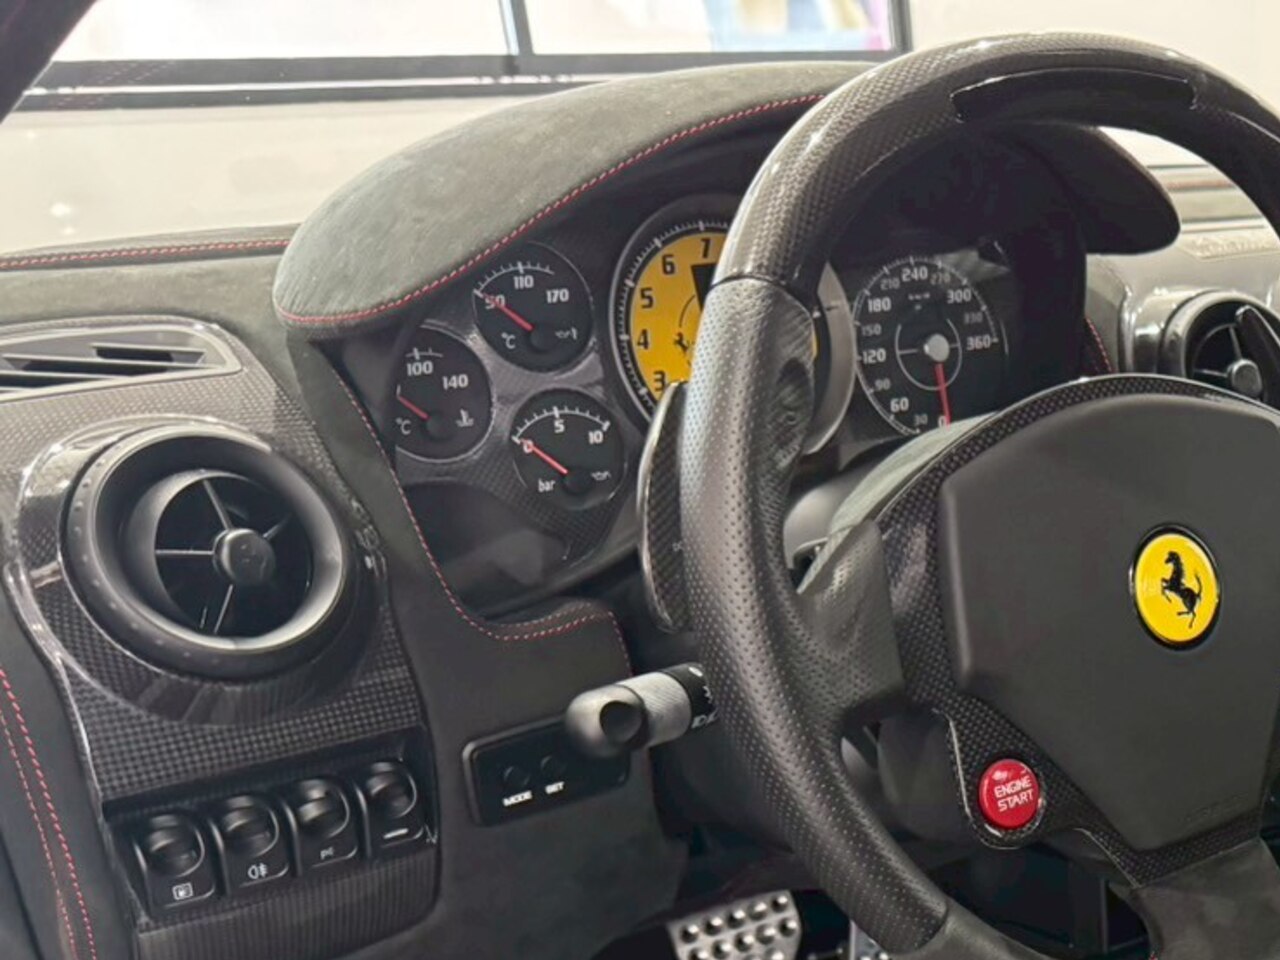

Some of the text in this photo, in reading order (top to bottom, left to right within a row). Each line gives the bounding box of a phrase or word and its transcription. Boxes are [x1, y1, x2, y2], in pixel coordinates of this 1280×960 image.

[701, 238, 711, 259] 7
[661, 255, 676, 275] 6
[513, 275, 534, 289] 110
[901, 266, 928, 282] 240
[546, 289, 570, 304] 170
[640, 288, 654, 308] 5
[947, 288, 972, 304] 300
[867, 297, 892, 313] 180
[637, 329, 649, 350] 4
[966, 335, 991, 350] 360
[862, 348, 887, 364] 120
[406, 361, 433, 376] 100
[442, 374, 469, 389] 140
[653, 371, 666, 392] 3
[890, 397, 909, 413] 60
[554, 420, 565, 434] 5
[588, 430, 604, 444] 10
[537, 479, 556, 492] bar
[994, 775, 1032, 798] ENGINE
[997, 789, 1034, 812] START
